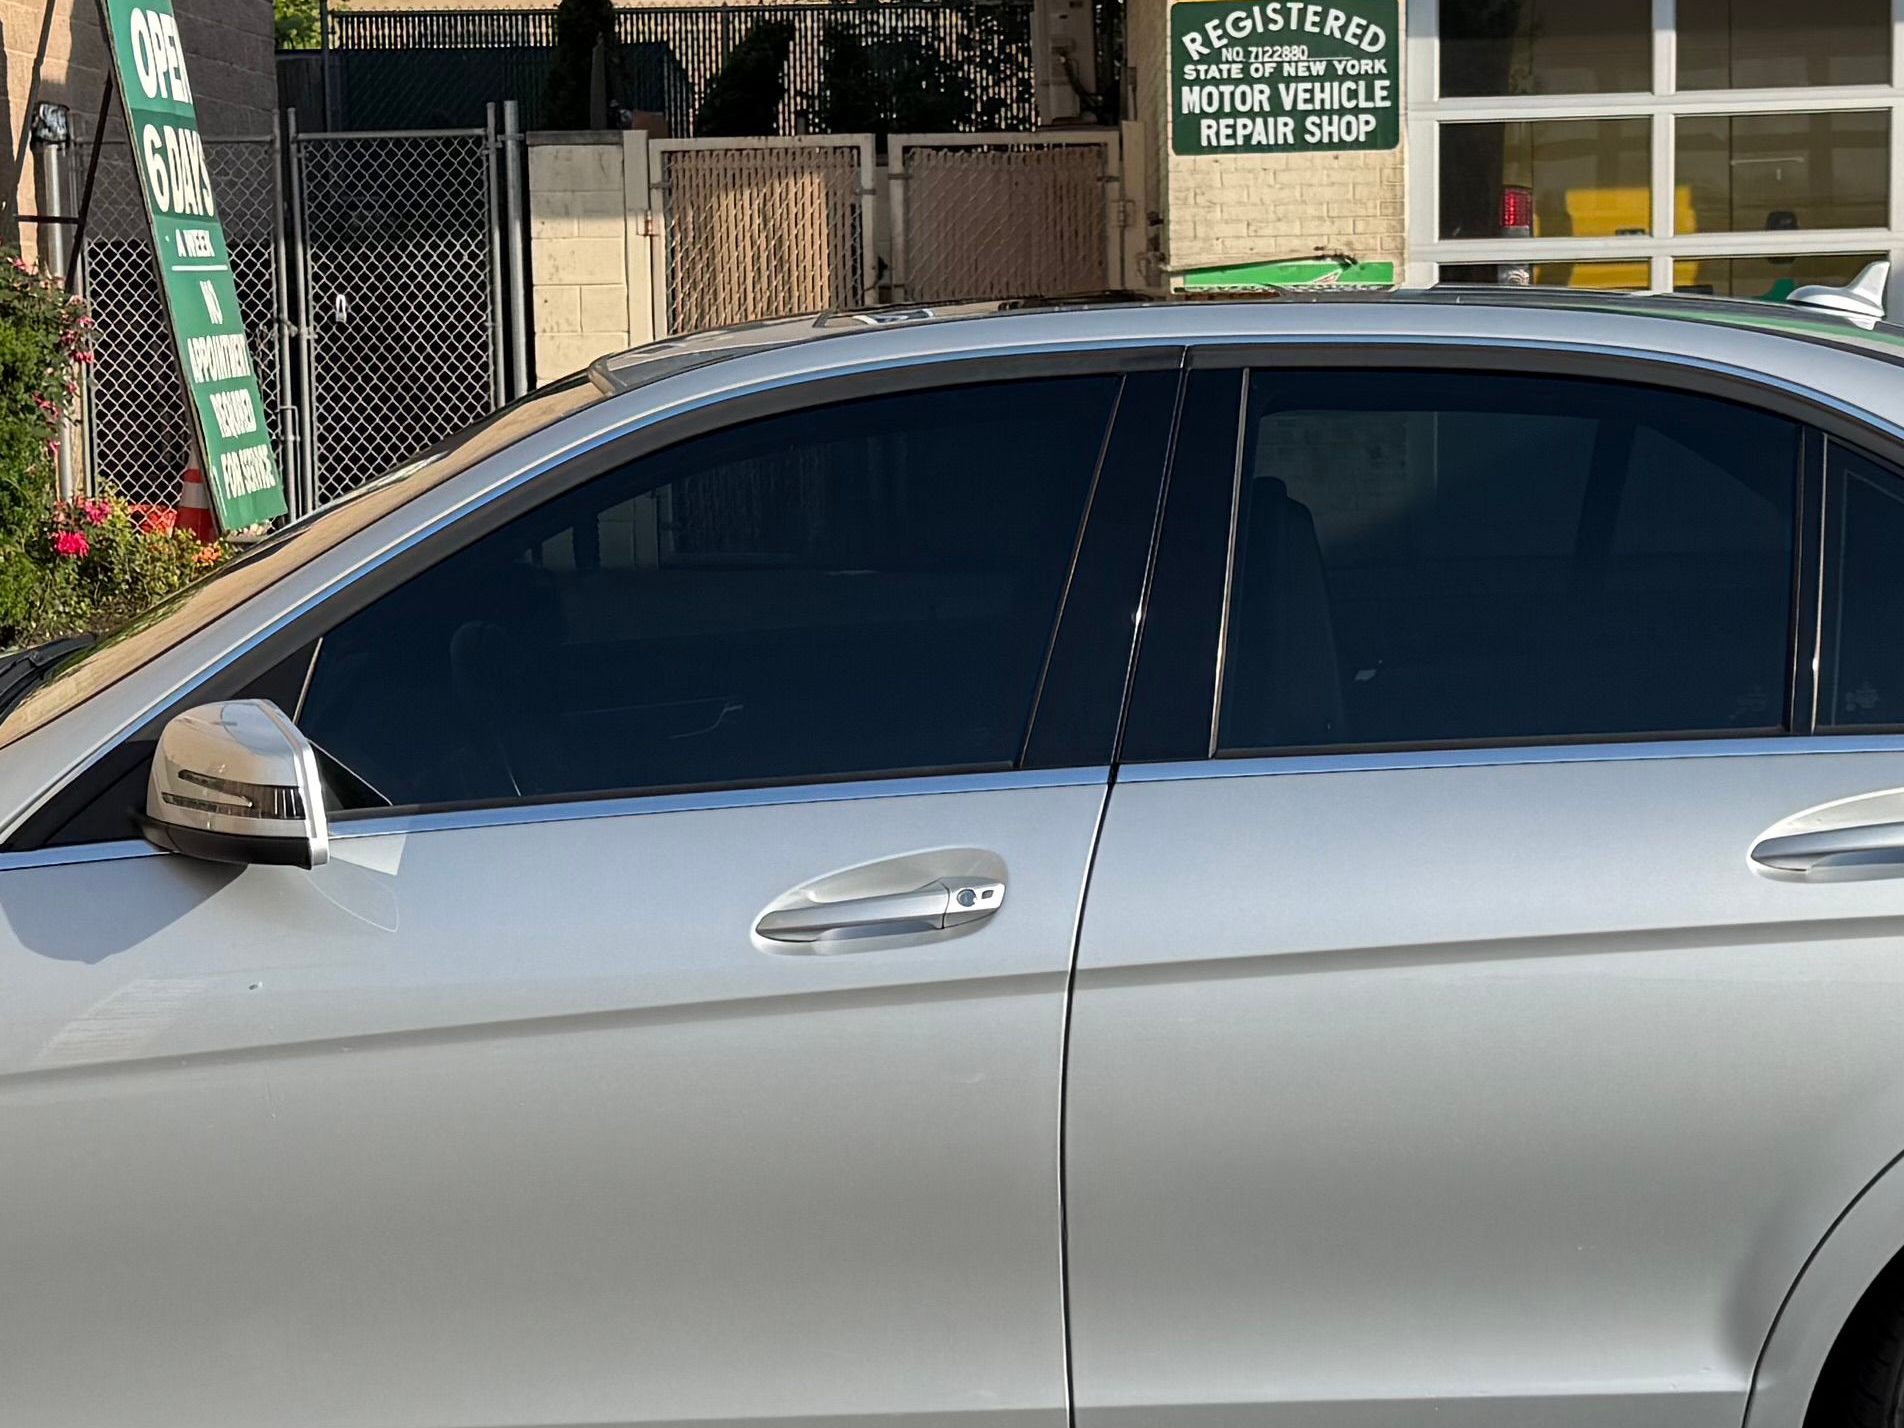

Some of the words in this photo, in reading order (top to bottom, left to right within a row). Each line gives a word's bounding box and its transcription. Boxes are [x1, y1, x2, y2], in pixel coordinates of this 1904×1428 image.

[1182, 2, 1386, 61] REGISTERED
[1183, 64, 1244, 80] STATE
[1250, 63, 1276, 78] OF
[1283, 61, 1327, 77] NEW
[1334, 59, 1388, 76] YORK
[1248, 45, 1308, 62] 7122880
[1181, 84, 1270, 114] MOTOR
[1279, 80, 1392, 111] VEHICLE
[1200, 117, 1295, 147] REPAIR
[1304, 114, 1377, 144] SHOP
[143, 124, 170, 213] 6
[163, 125, 214, 217] DAYS
[175, 229, 186, 257] A
